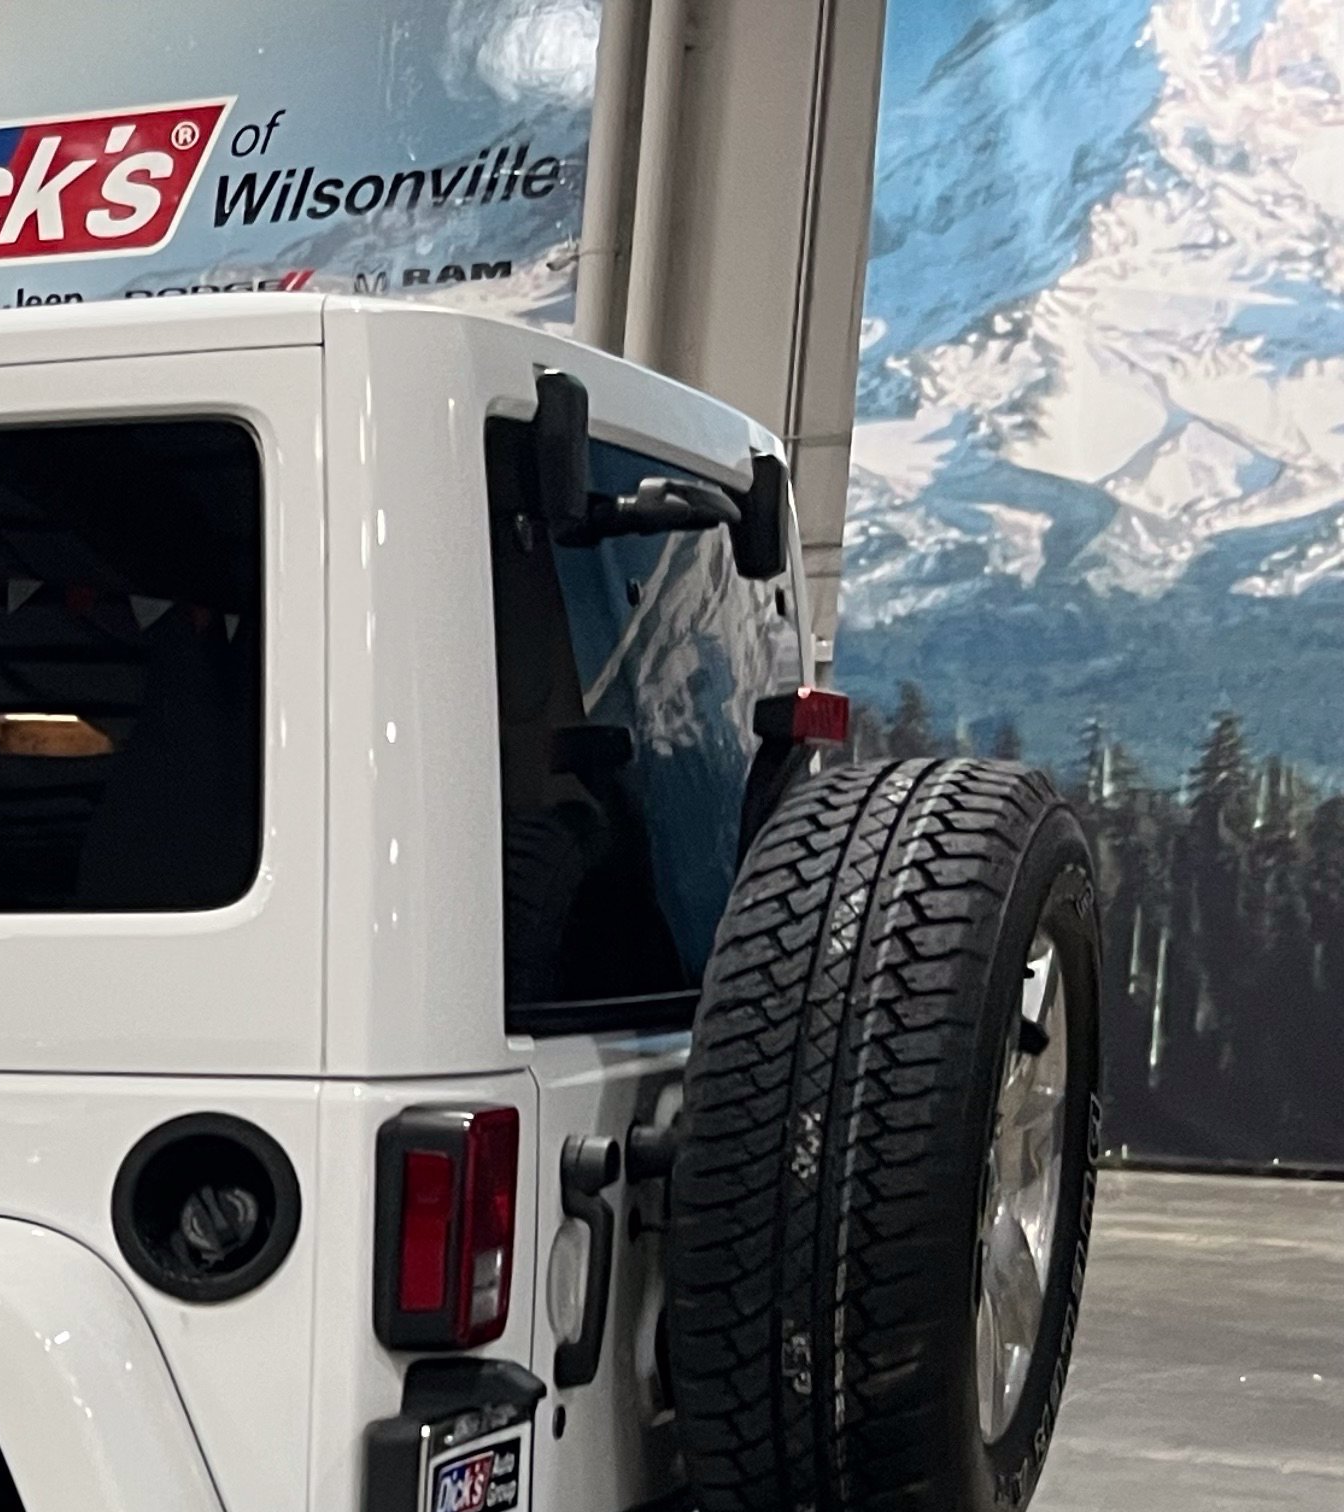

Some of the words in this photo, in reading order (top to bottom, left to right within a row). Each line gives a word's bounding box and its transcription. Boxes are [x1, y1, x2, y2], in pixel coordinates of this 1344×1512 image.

[231, 110, 286, 157] of
[214, 142, 559, 228] Wilsonville
[402, 260, 511, 287] RAM
